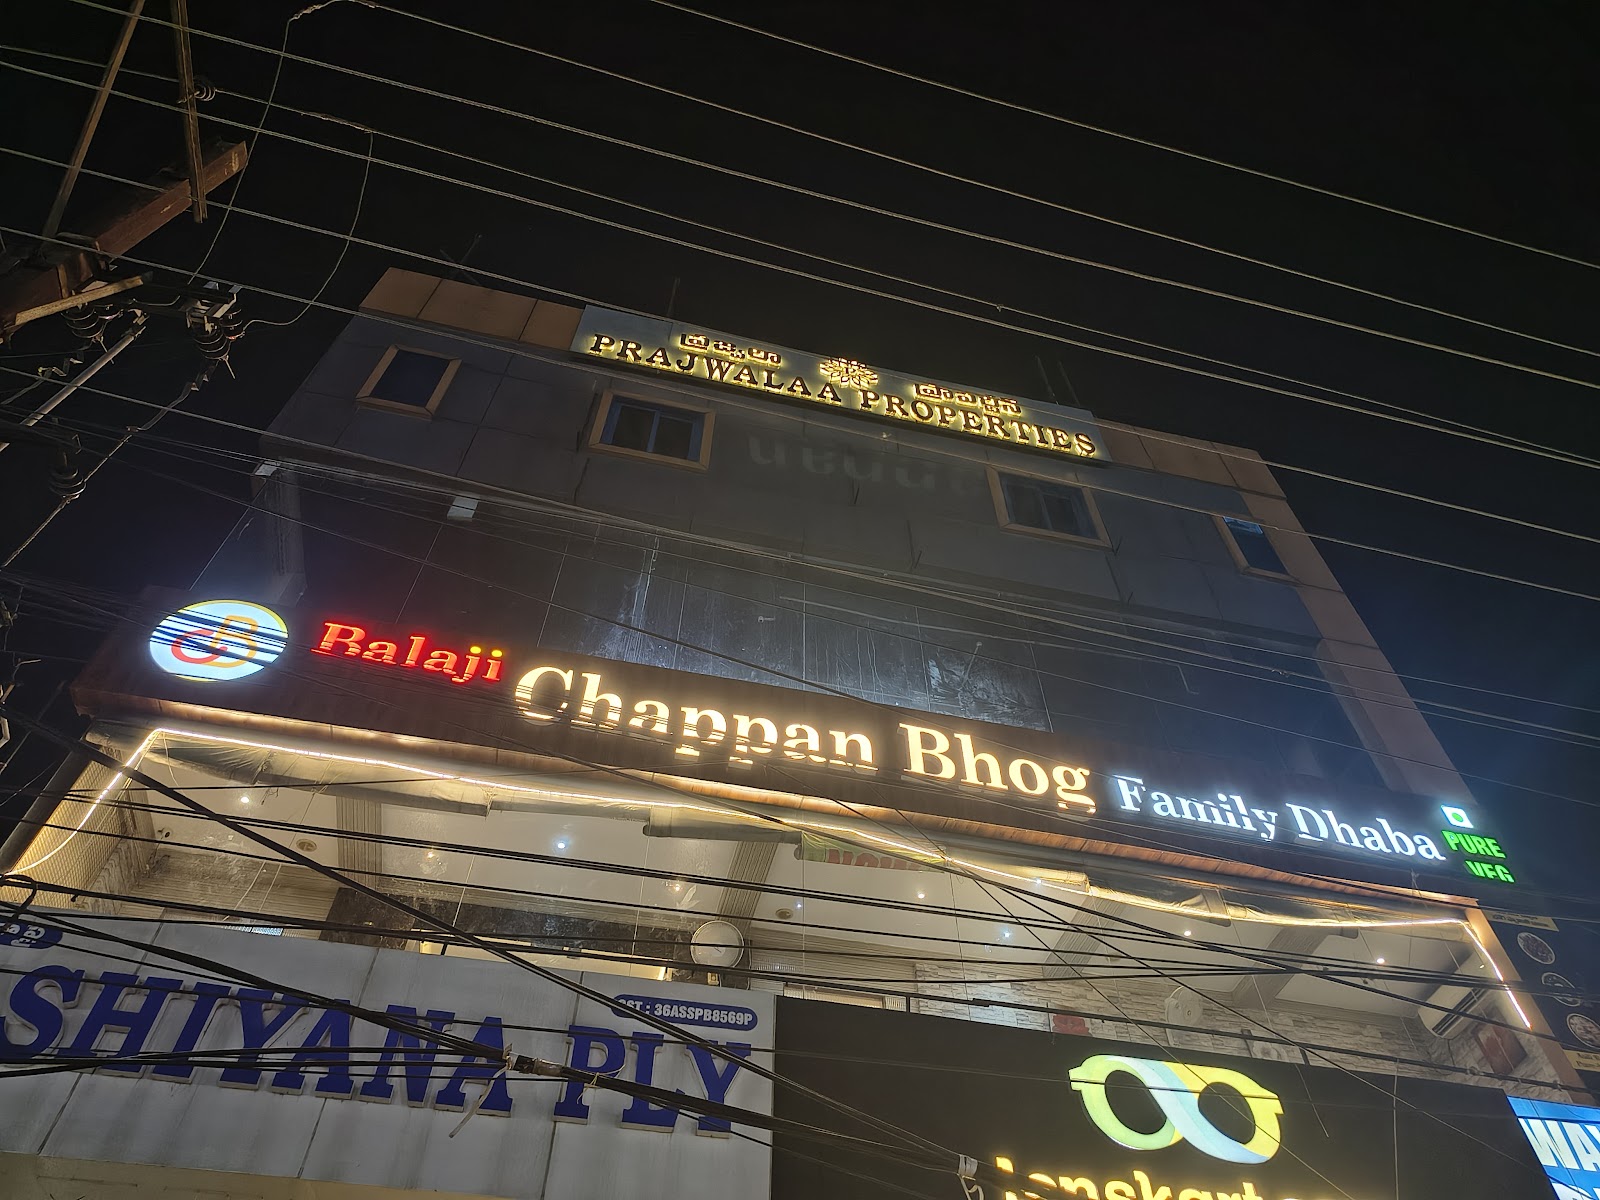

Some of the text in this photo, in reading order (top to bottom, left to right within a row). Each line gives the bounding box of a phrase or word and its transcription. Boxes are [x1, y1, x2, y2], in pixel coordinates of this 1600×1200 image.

[588, 332, 1097, 458] PRAJWALAA PROPERTIES
[311, 622, 1447, 861] Balaji Chappan Bhog Family Dhaba
[1441, 830, 1506, 858] PURE
[1465, 860, 1515, 883] VEG
[0, 964, 752, 1134] SHIYANA PLY
[654, 1003, 753, 1026] 36ASSPB8569P
